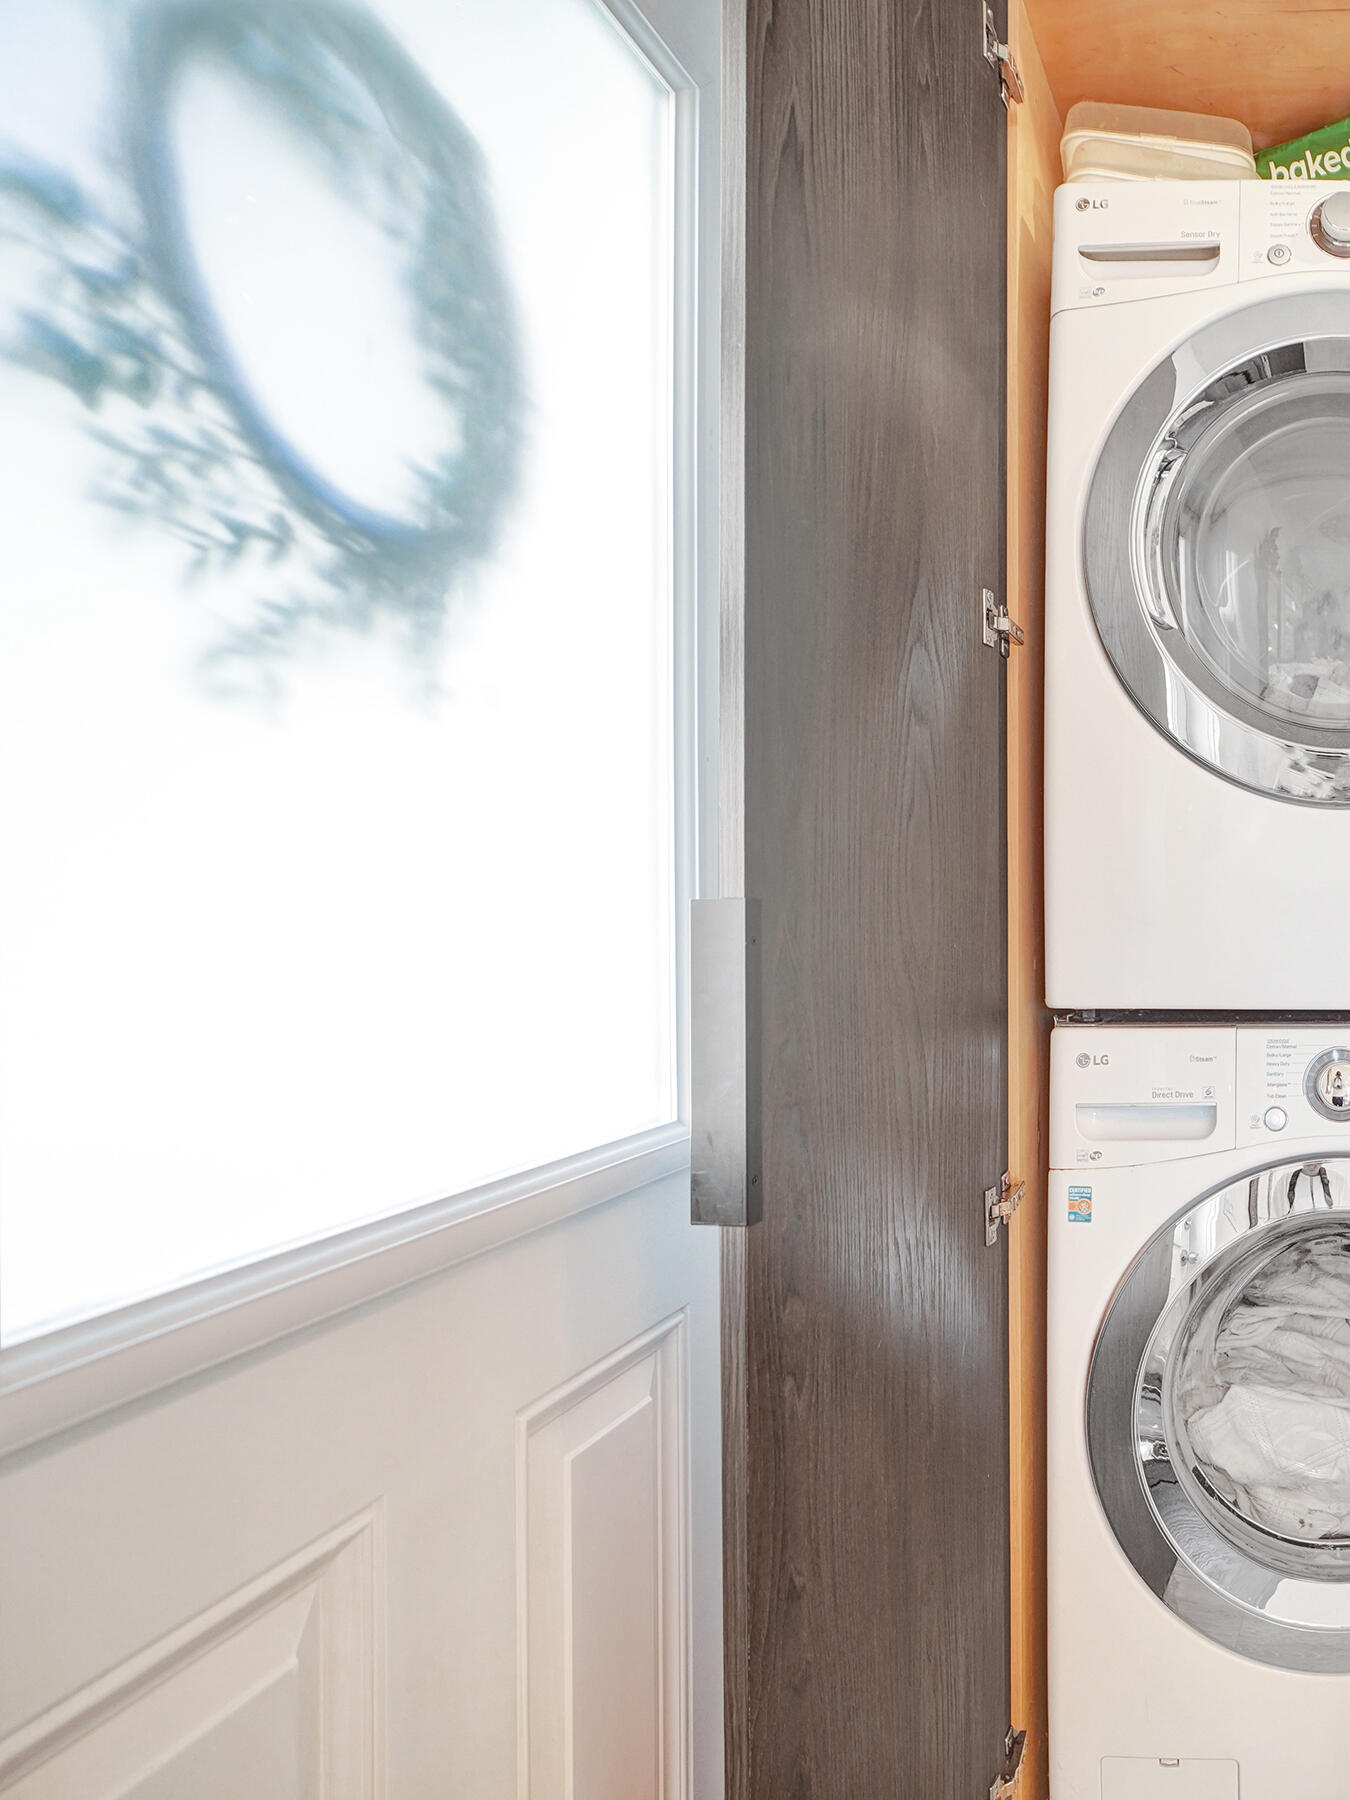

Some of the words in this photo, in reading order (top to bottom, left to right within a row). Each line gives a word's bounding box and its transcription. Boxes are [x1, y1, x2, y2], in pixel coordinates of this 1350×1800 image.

[1180, 230, 1206, 239] Sensor
[1208, 230, 1221, 239] Dry
[1151, 1090, 1174, 1099] Direct
[1175, 1090, 1194, 1099] Drive
